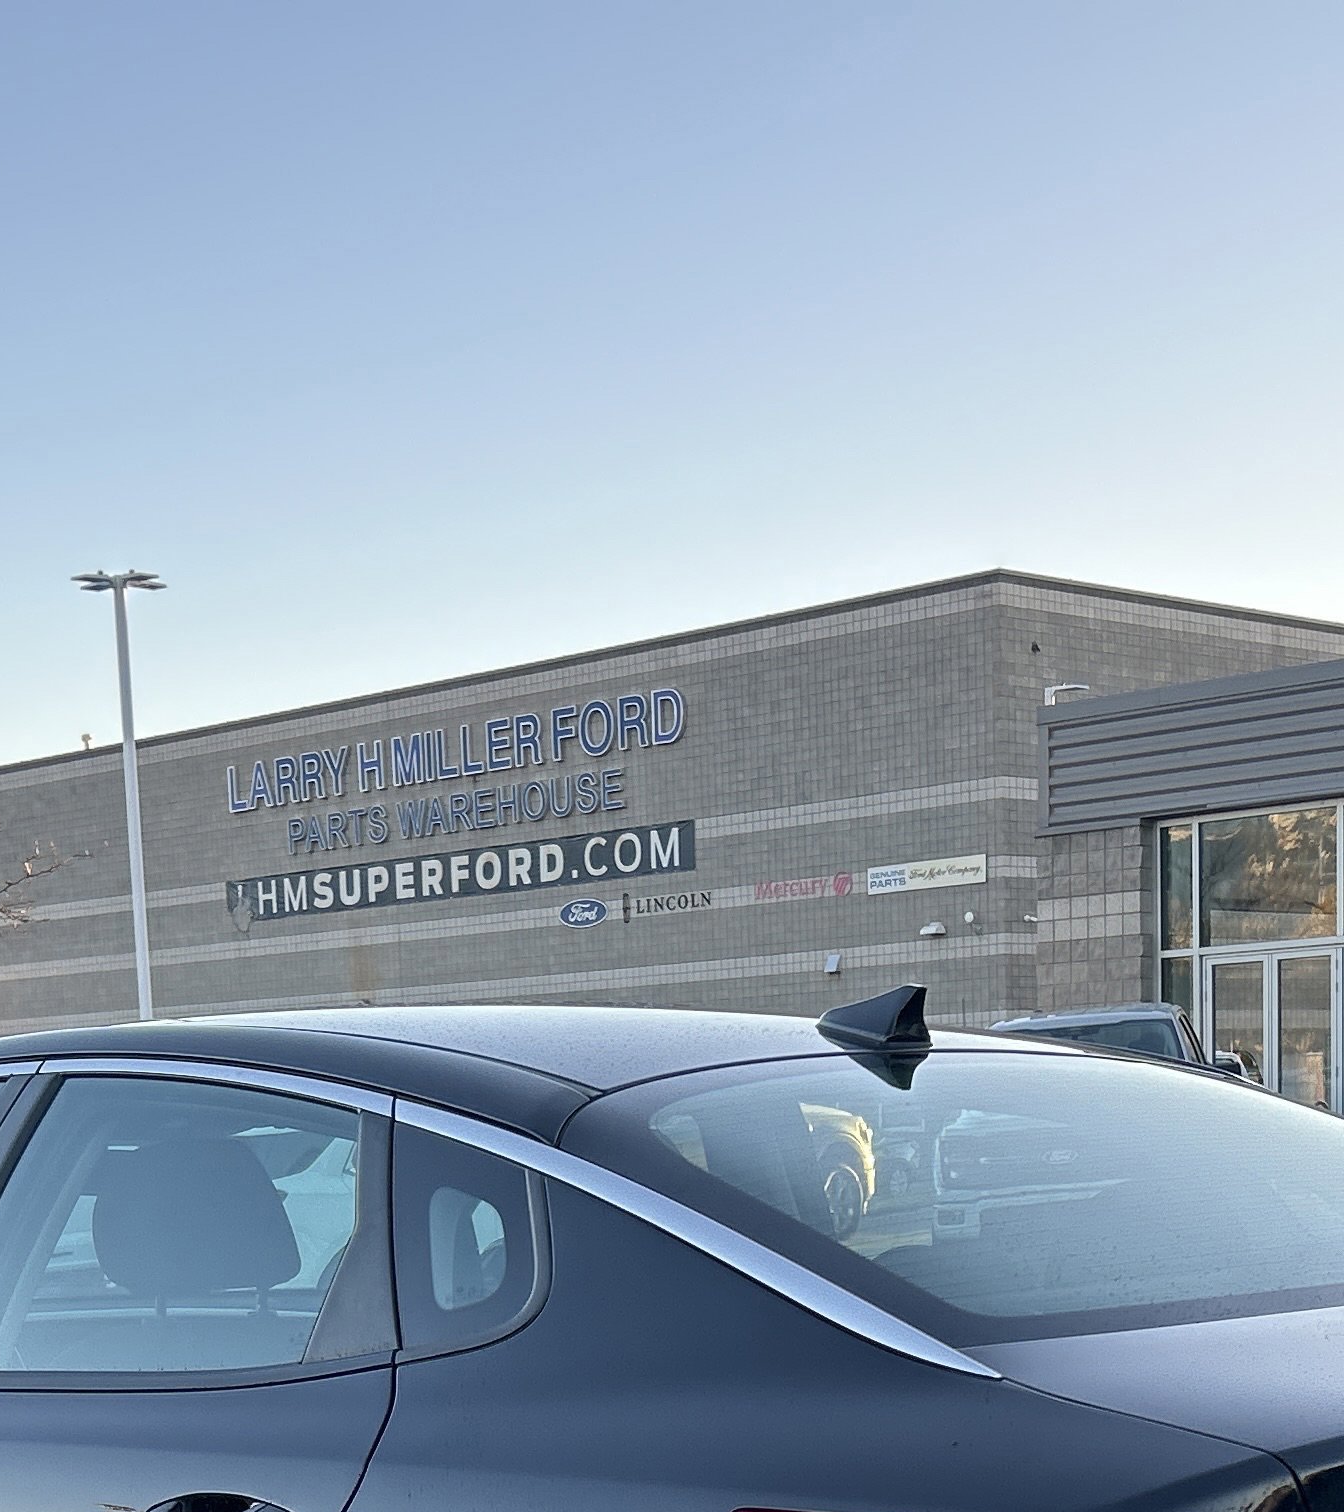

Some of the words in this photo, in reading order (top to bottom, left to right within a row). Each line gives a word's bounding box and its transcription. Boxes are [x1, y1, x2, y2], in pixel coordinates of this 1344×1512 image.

[227, 746, 348, 814] LARRY
[358, 740, 383, 793] H
[391, 713, 542, 786] MILLER
[551, 688, 685, 762] FORD
[288, 805, 389, 855] PARTS
[400, 768, 625, 840] WAREHOUSE
[869, 869, 906, 879] GENUINE
[869, 877, 907, 889] PARTS
[755, 877, 827, 900] Mercury
[568, 903, 598, 923] Ford
[636, 892, 712, 914] LINCOLN
